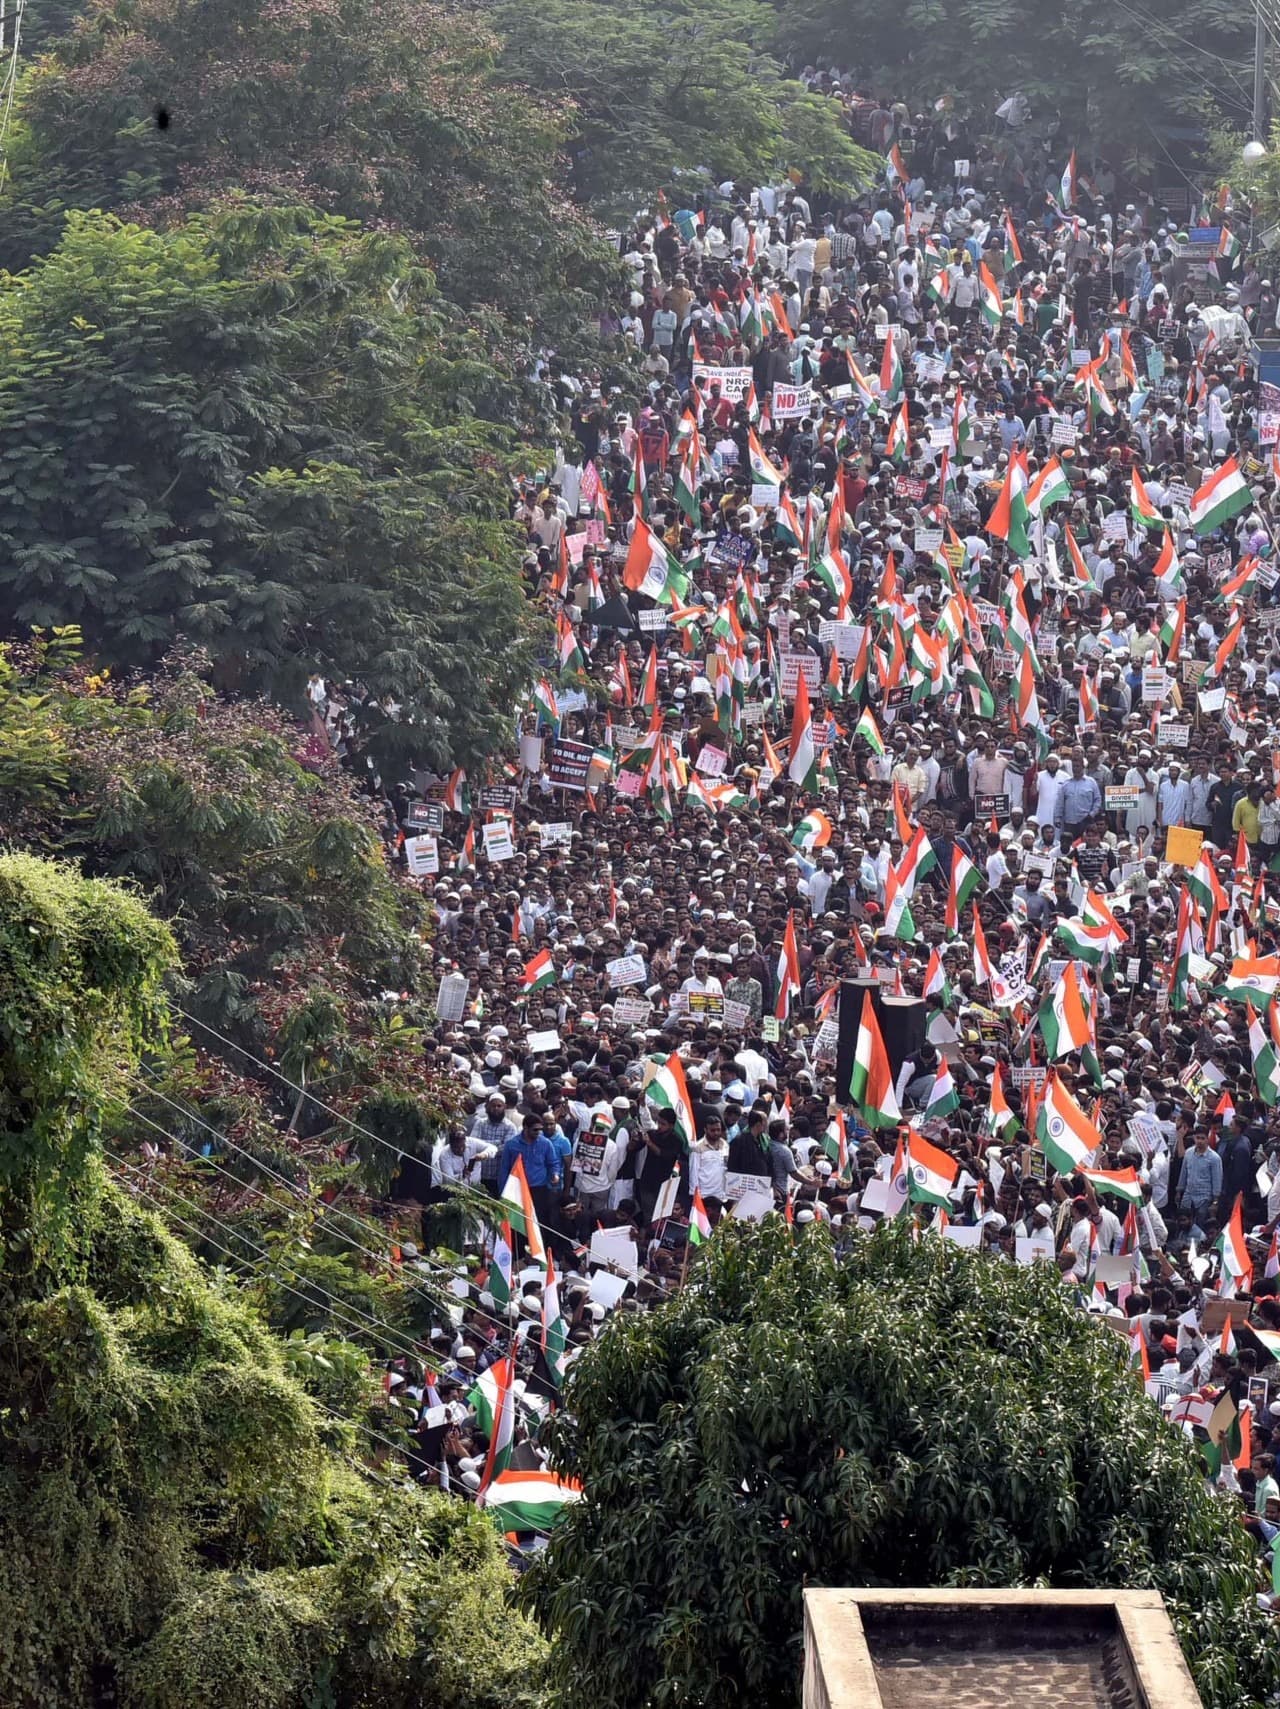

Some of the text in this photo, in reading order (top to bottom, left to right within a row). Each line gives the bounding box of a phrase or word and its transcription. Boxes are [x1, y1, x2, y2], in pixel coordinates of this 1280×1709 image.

[726, 378, 750, 386] NRC
[777, 393, 796, 408] NO
[797, 399, 811, 407] CAA
[554, 748, 562, 756] TO
[576, 753, 590, 762] BUT
[552, 764, 586, 777] TO ACCEPT
[1004, 963, 1024, 980] NR
